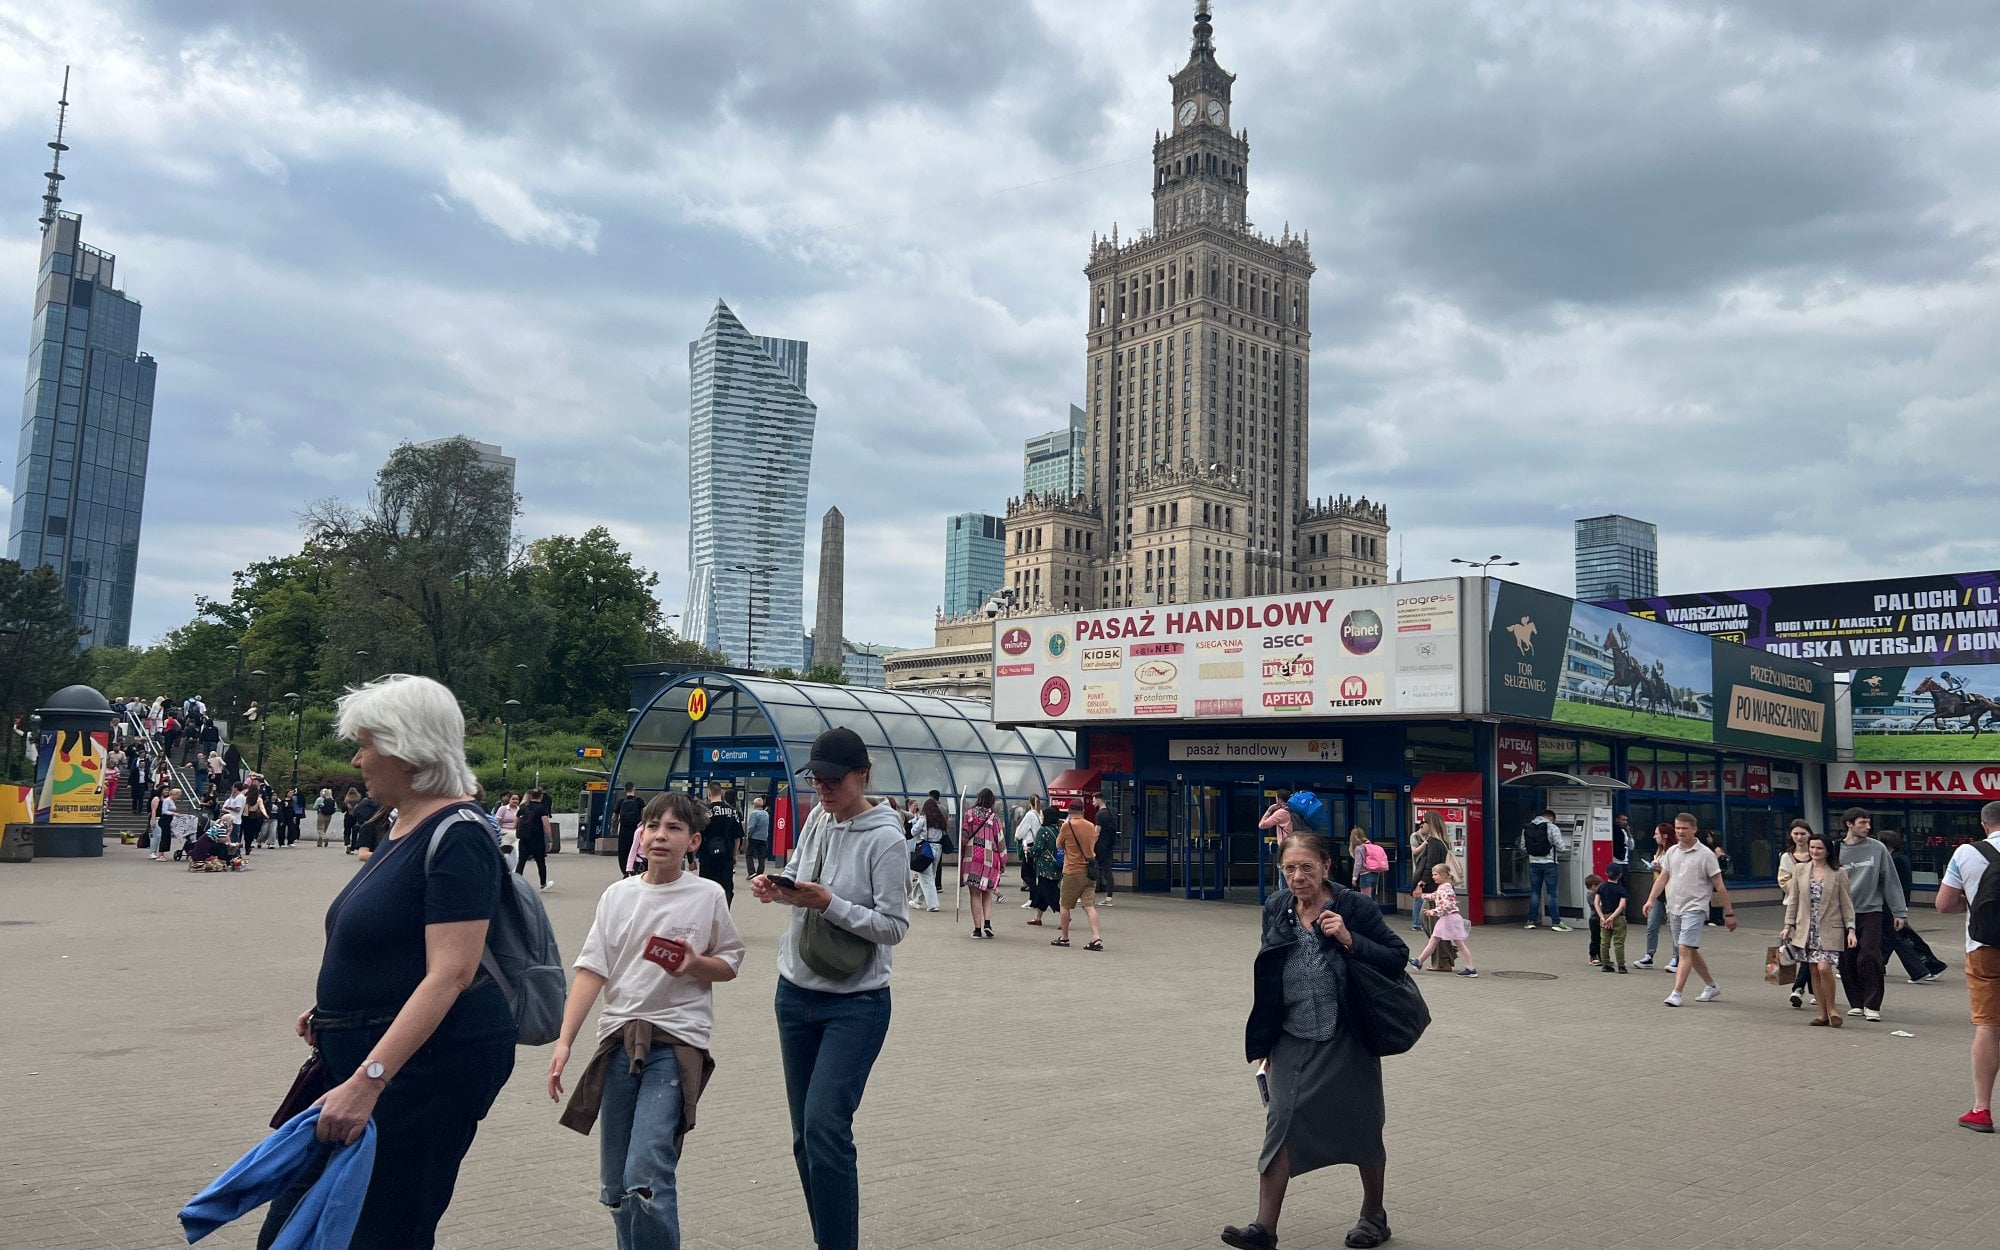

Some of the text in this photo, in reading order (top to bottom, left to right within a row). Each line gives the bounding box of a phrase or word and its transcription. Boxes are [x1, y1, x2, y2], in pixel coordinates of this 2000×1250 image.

[1396, 594, 1455, 607] progress
[1873, 589, 1958, 612] PALUCH
[1977, 587, 2000, 605] O.
[1075, 609, 1155, 642] PASAŻ
[1166, 598, 1335, 634] HANDLOWY
[1666, 603, 1748, 622] WARSZAWA
[1700, 619, 1749, 632] URSYNÓW
[1774, 620, 1801, 632] BUGI
[1803, 619, 1830, 630] WTH
[1839, 615, 1893, 629] MACIĘTY
[1911, 609, 2000, 632] GRAMM
[1343, 623, 1379, 637] Planet
[1004, 641, 1028, 649] minute
[1263, 634, 1304, 649] asec
[1766, 640, 1843, 658] POLSKA
[1849, 635, 1938, 656] WERSJA
[1084, 650, 1120, 660] KIOSK
[1263, 662, 1313, 677] metro
[1517, 661, 1533, 676] TOR
[1504, 673, 1546, 693] SŁUŻEWIEC
[1750, 665, 1813, 694] PRZEŻYJ WEEKEND
[690, 693, 704, 714] M
[1264, 692, 1312, 705] APTEKA
[1329, 698, 1382, 707] TELEFONY
[1736, 695, 1820, 733] PO WARSZAWSKU
[1186, 743, 1288, 758] pasaż handlowy
[1499, 736, 1533, 752] APTEKA
[721, 750, 748, 760] Centrum
[1843, 769, 1968, 792] APTEKA
[649, 945, 679, 963] KFC
